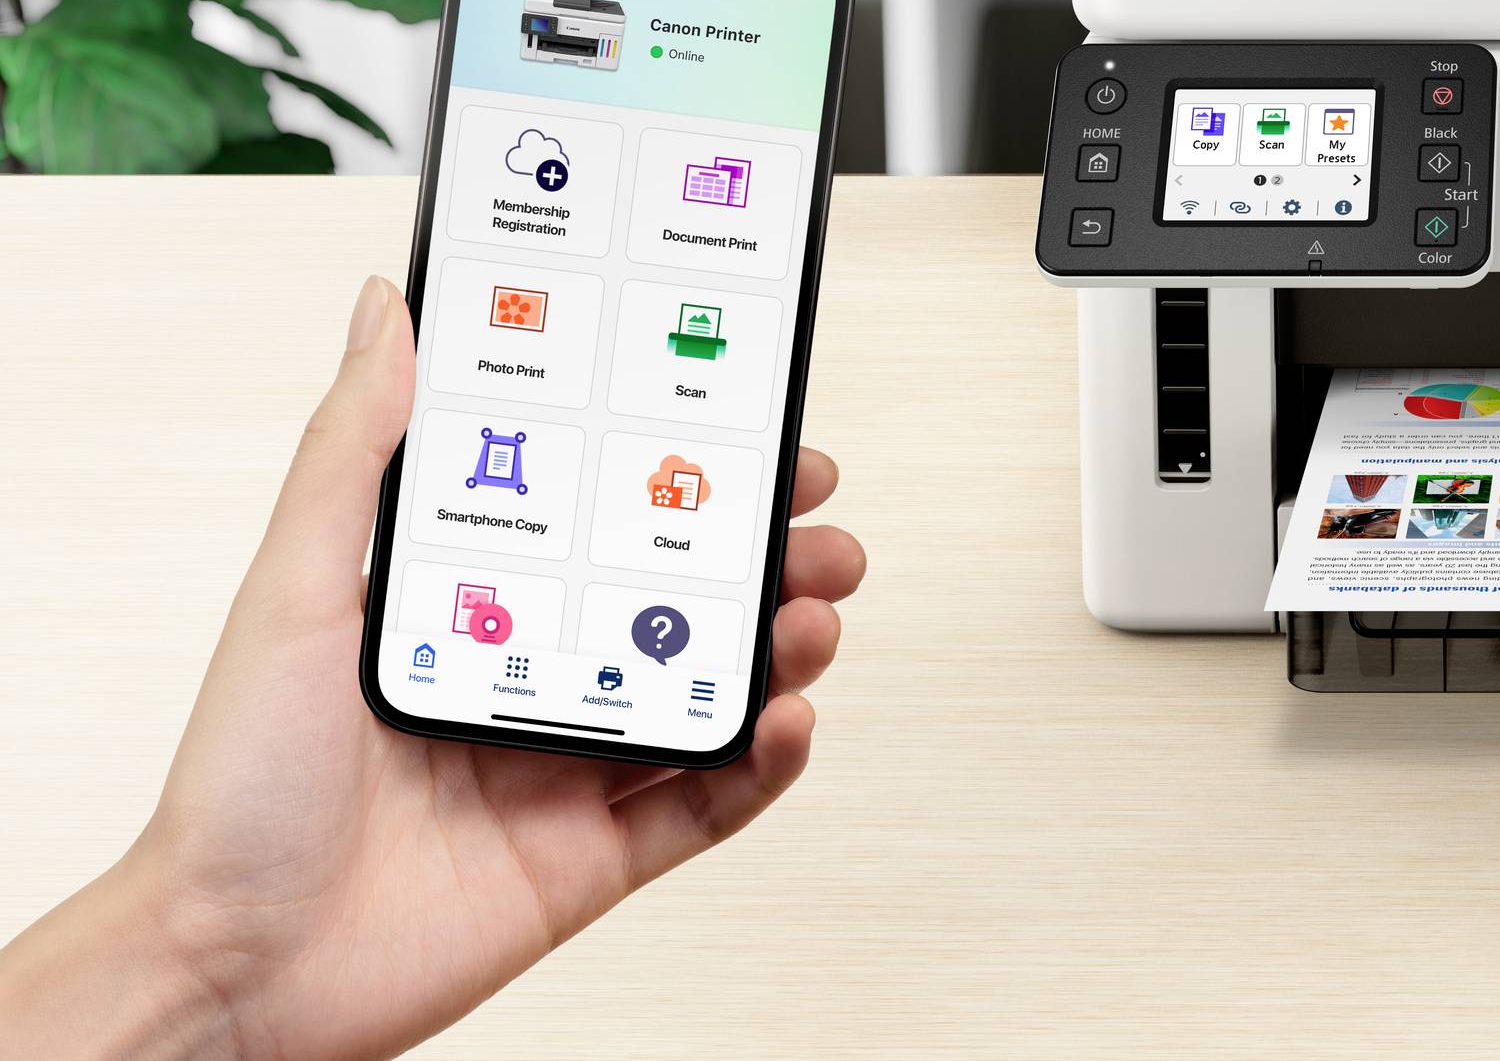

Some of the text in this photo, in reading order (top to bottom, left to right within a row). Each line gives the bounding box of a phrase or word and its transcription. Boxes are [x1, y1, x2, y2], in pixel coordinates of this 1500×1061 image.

[650, 18, 761, 44] Canon Printer
[668, 48, 705, 64] Online
[1430, 60, 1458, 73] Stop
[1083, 127, 1121, 139] HOME
[1424, 126, 1458, 139] Black
[1192, 140, 1220, 152] Copy
[1259, 140, 1285, 150] Scan
[1329, 140, 1346, 152] My
[1317, 153, 1356, 164] Presets
[1257, 176, 1281, 184] 1 2
[1444, 188, 1478, 202] Start
[493, 199, 570, 219] Membership
[492, 217, 567, 237] Registration
[662, 229, 758, 252] Document Print
[1418, 252, 1453, 264] Color
[478, 359, 545, 379] Photo Print
[675, 385, 707, 399] Scan
[436, 509, 548, 535] Smartphone Copy
[653, 536, 690, 551] Cloud
[408, 673, 435, 684] Home
[493, 684, 536, 697] Functions
[582, 694, 632, 710] Add/Switch
[687, 708, 712, 719] Menu
